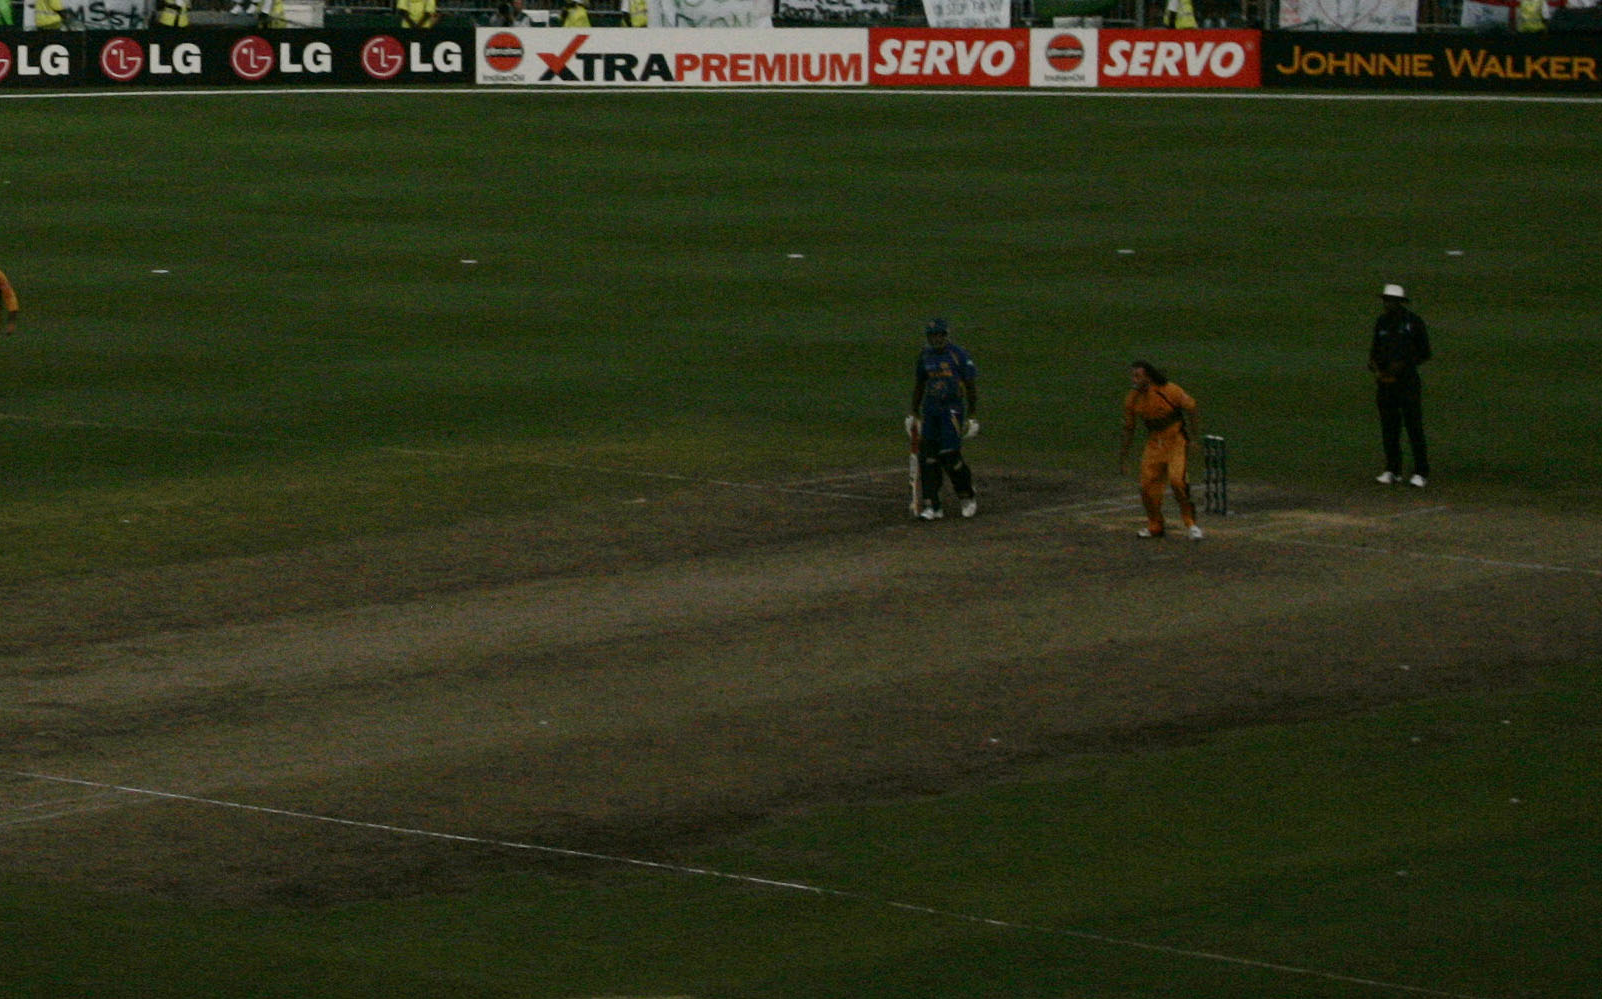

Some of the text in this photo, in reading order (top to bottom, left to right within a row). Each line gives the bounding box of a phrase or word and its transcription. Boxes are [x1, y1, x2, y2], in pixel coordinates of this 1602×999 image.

[16, 43, 70, 77] LG
[148, 43, 202, 75] LG
[279, 42, 333, 74] LG
[409, 41, 462, 73] LG
[873, 39, 1015, 77] SERVO
[1102, 39, 1247, 77] SERVO
[1276, 45, 1598, 81] JOHNNIE WALKER
